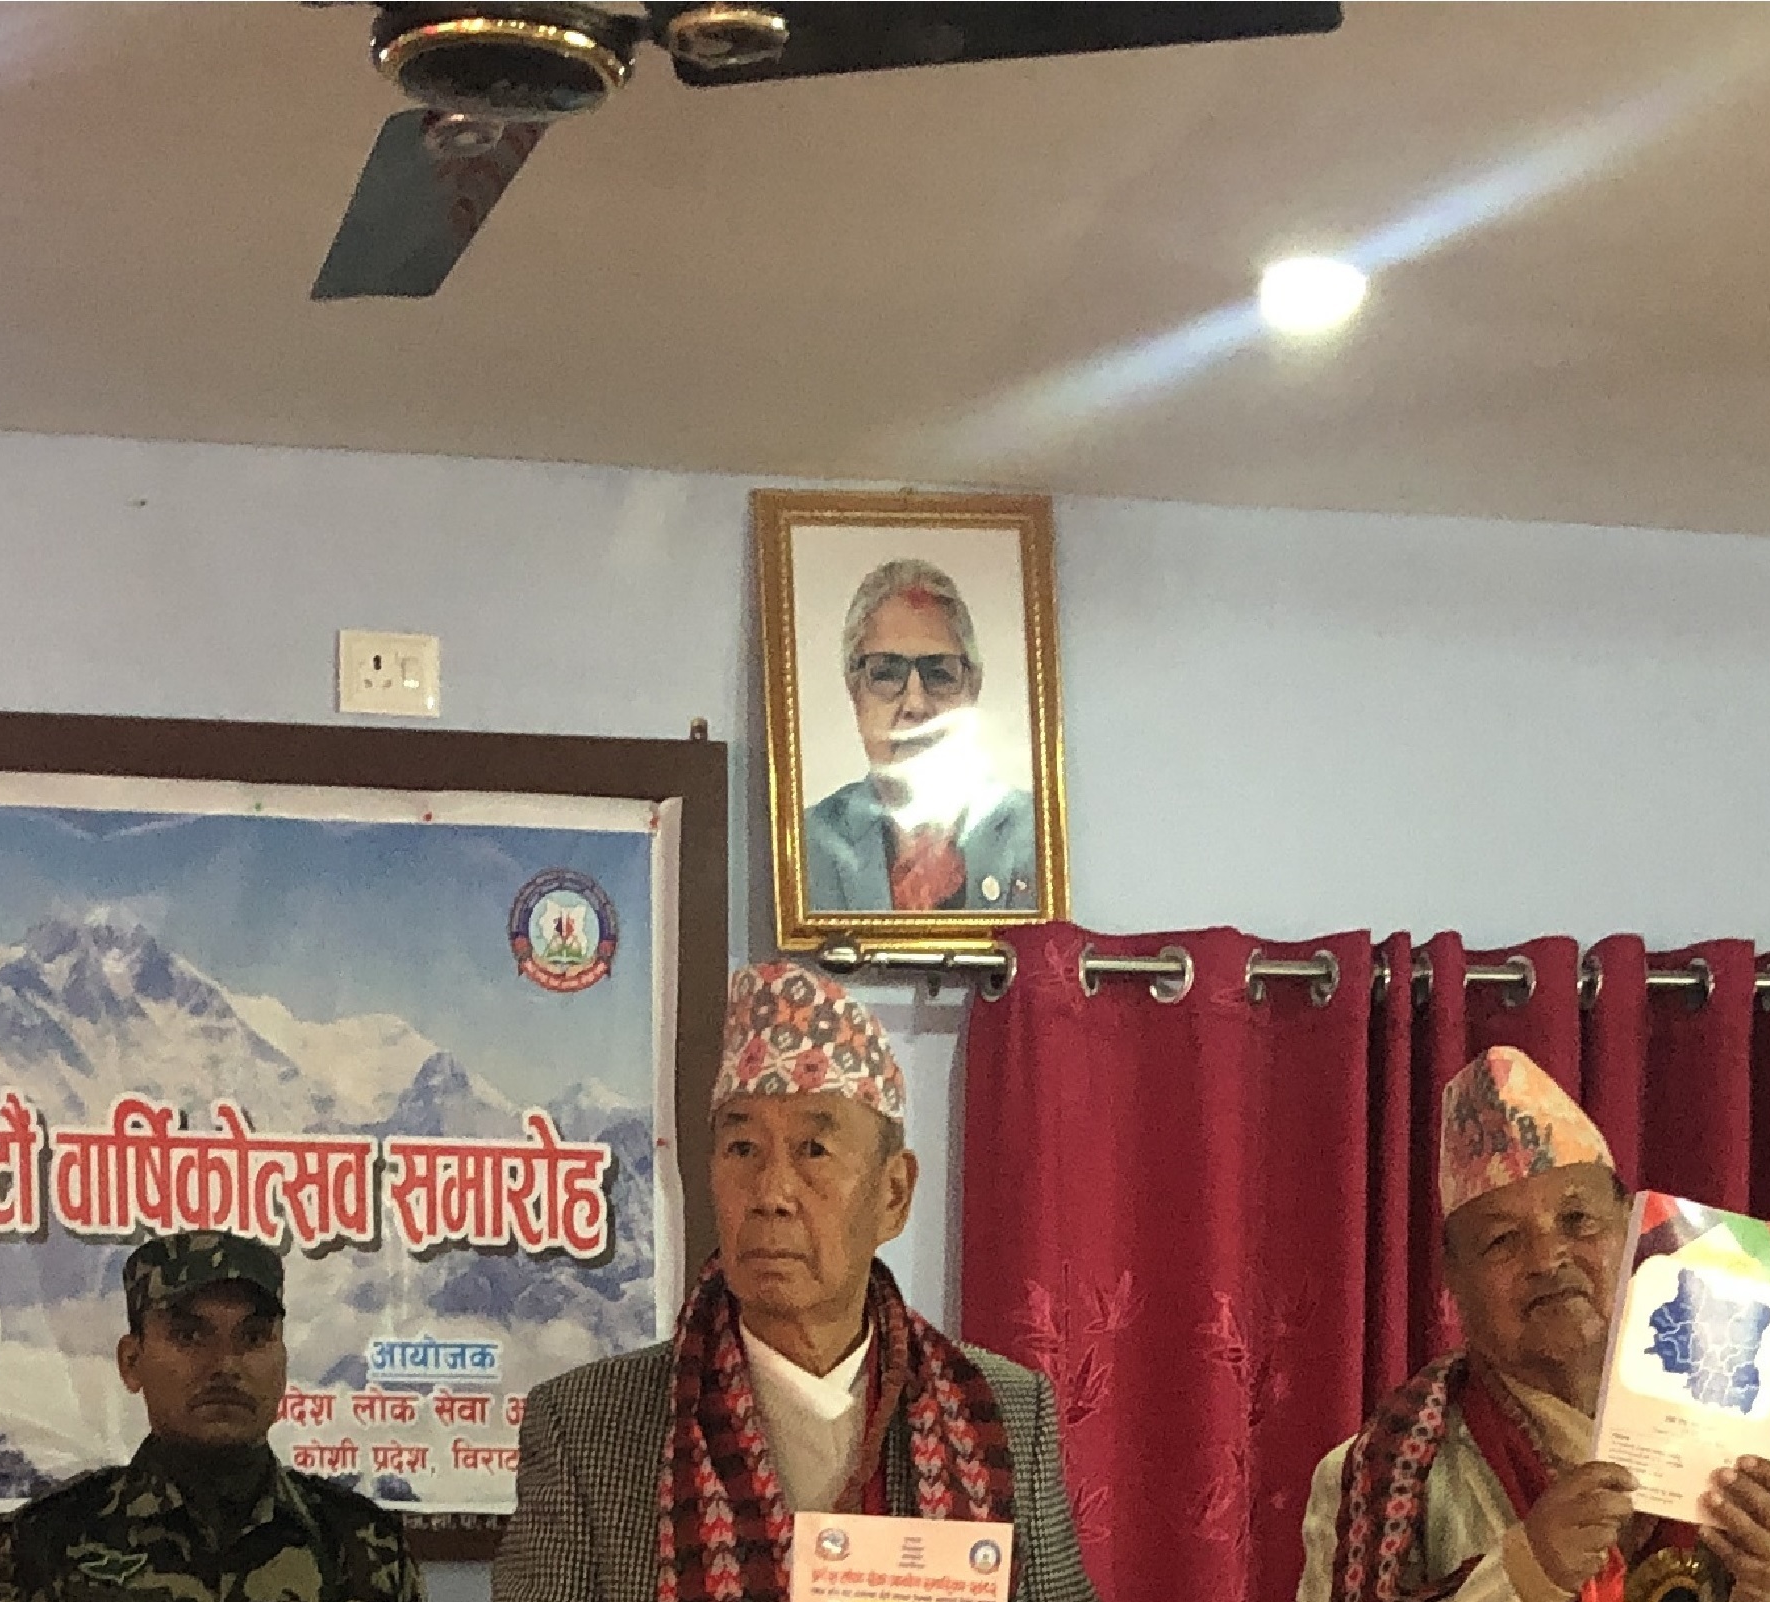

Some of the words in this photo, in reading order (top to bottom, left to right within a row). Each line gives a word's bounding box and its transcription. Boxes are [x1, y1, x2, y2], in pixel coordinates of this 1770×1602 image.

[56, 1098, 372, 1243] वार्षिकोत्सव
[390, 1114, 606, 1253] समारोह
[371, 1335, 498, 1370] आयोजक
[352, 1386, 419, 1425] लोक
[432, 1388, 490, 1424] सेवा
[293, 1438, 359, 1472] कोशी
[451, 1438, 520, 1475] विराट
